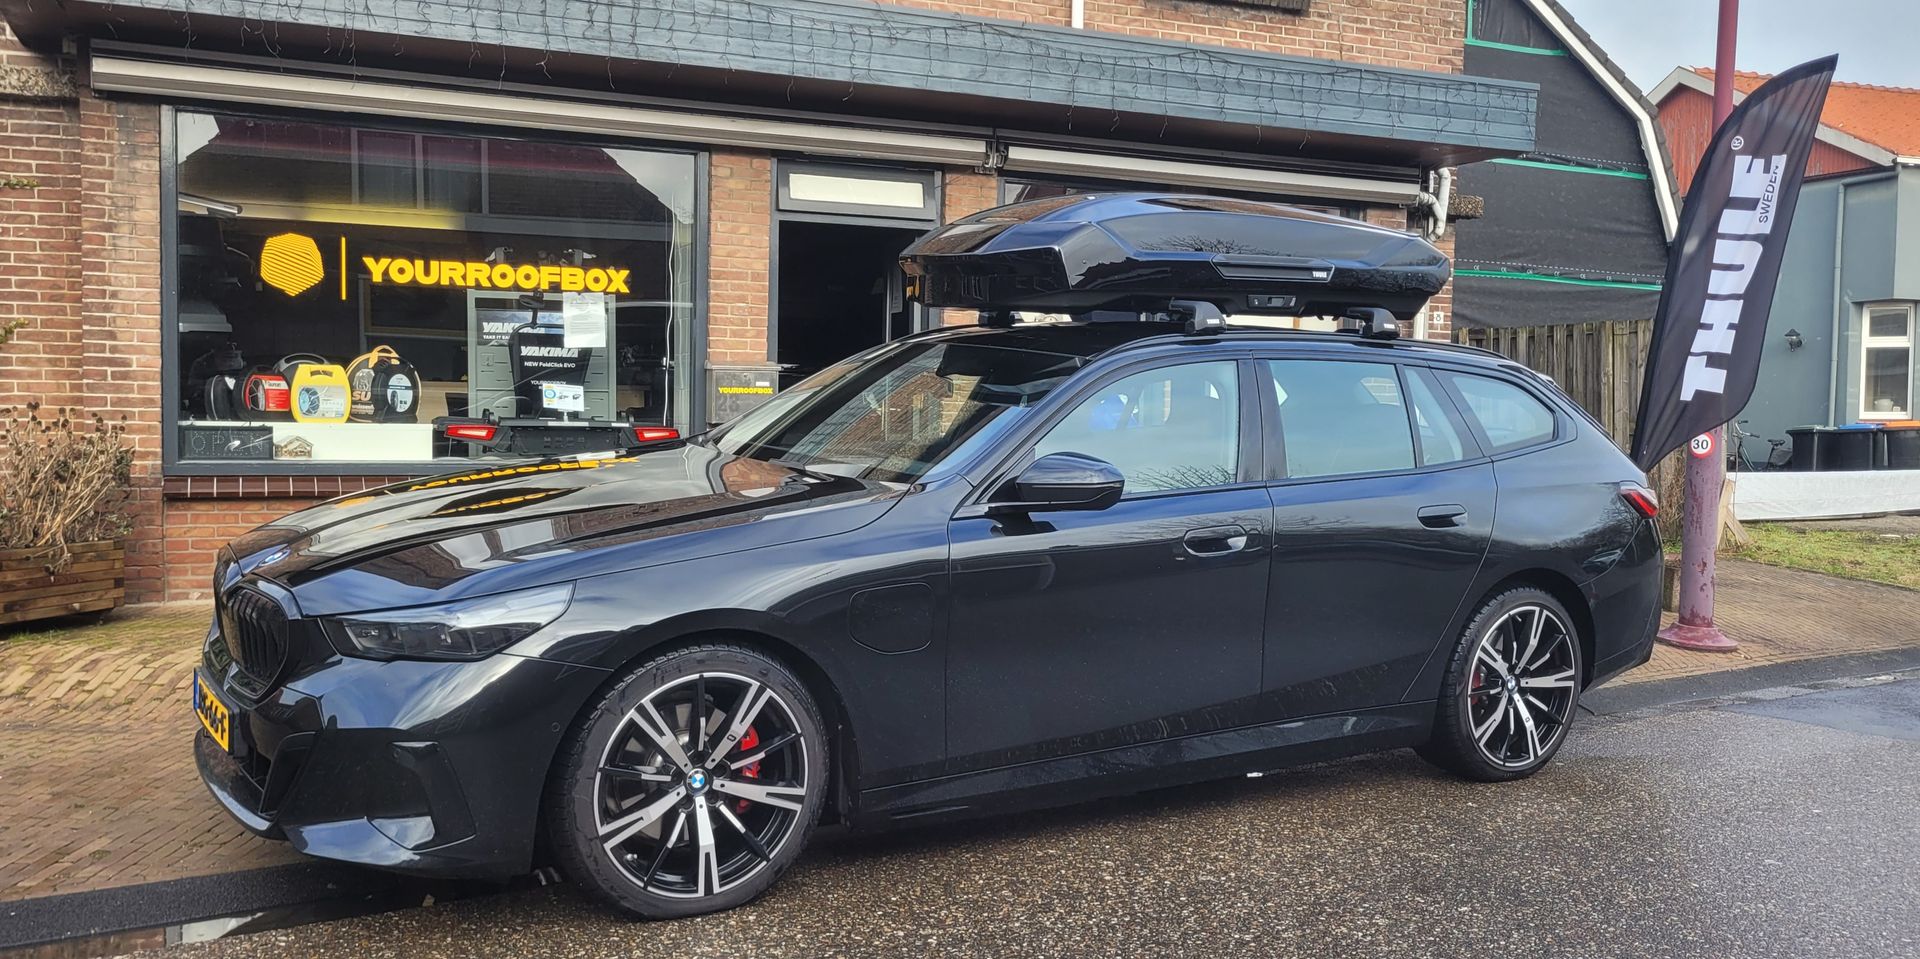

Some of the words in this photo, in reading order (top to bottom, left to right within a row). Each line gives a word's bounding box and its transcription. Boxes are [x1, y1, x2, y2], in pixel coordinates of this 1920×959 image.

[362, 256, 631, 294] YOURROOFBOX
[1680, 154, 1787, 400] THULE
[520, 345, 579, 358] YAKIMA
[1692, 438, 1709, 450] 30
